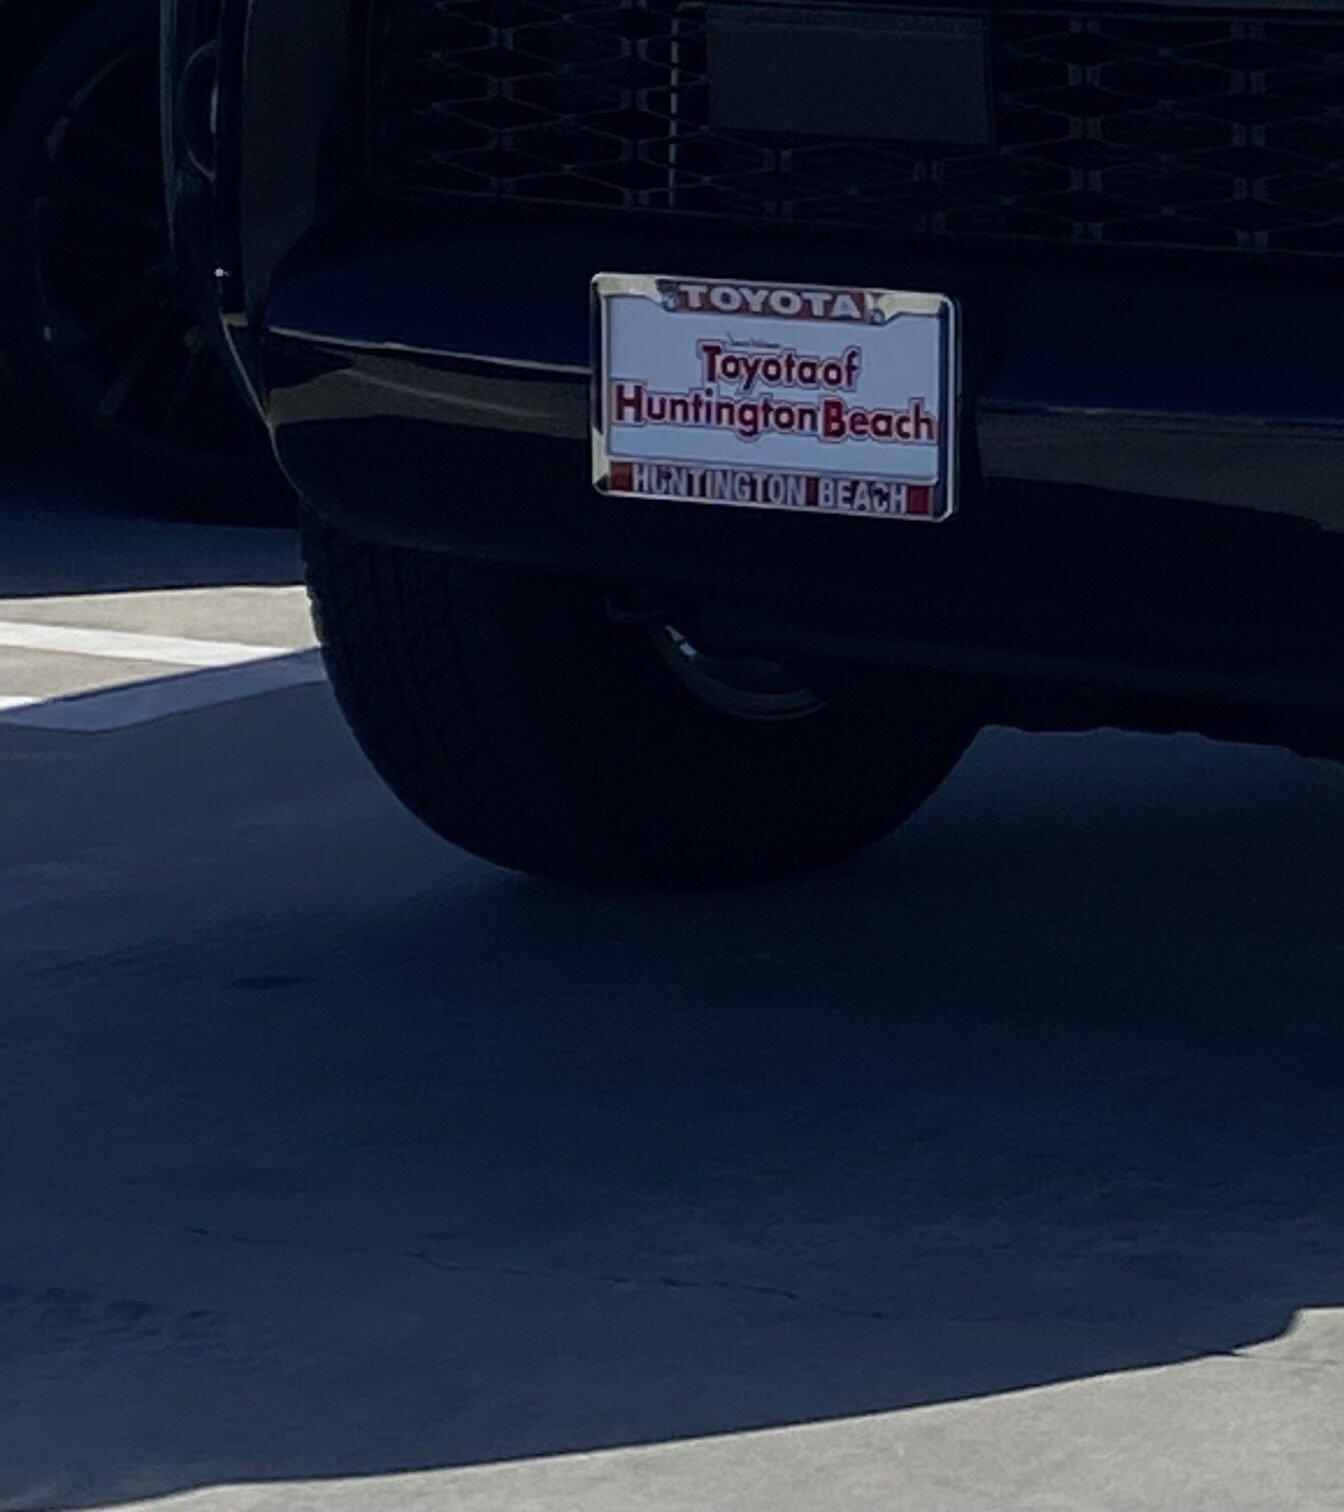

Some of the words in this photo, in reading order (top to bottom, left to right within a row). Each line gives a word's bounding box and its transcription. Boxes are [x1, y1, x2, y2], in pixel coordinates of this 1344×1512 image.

[680, 285, 861, 319] TOYOTA
[616, 385, 818, 436] Huntington
[822, 399, 934, 439] Beach
[633, 464, 810, 506] HUNTINGTON
[819, 476, 907, 513] BEACH
